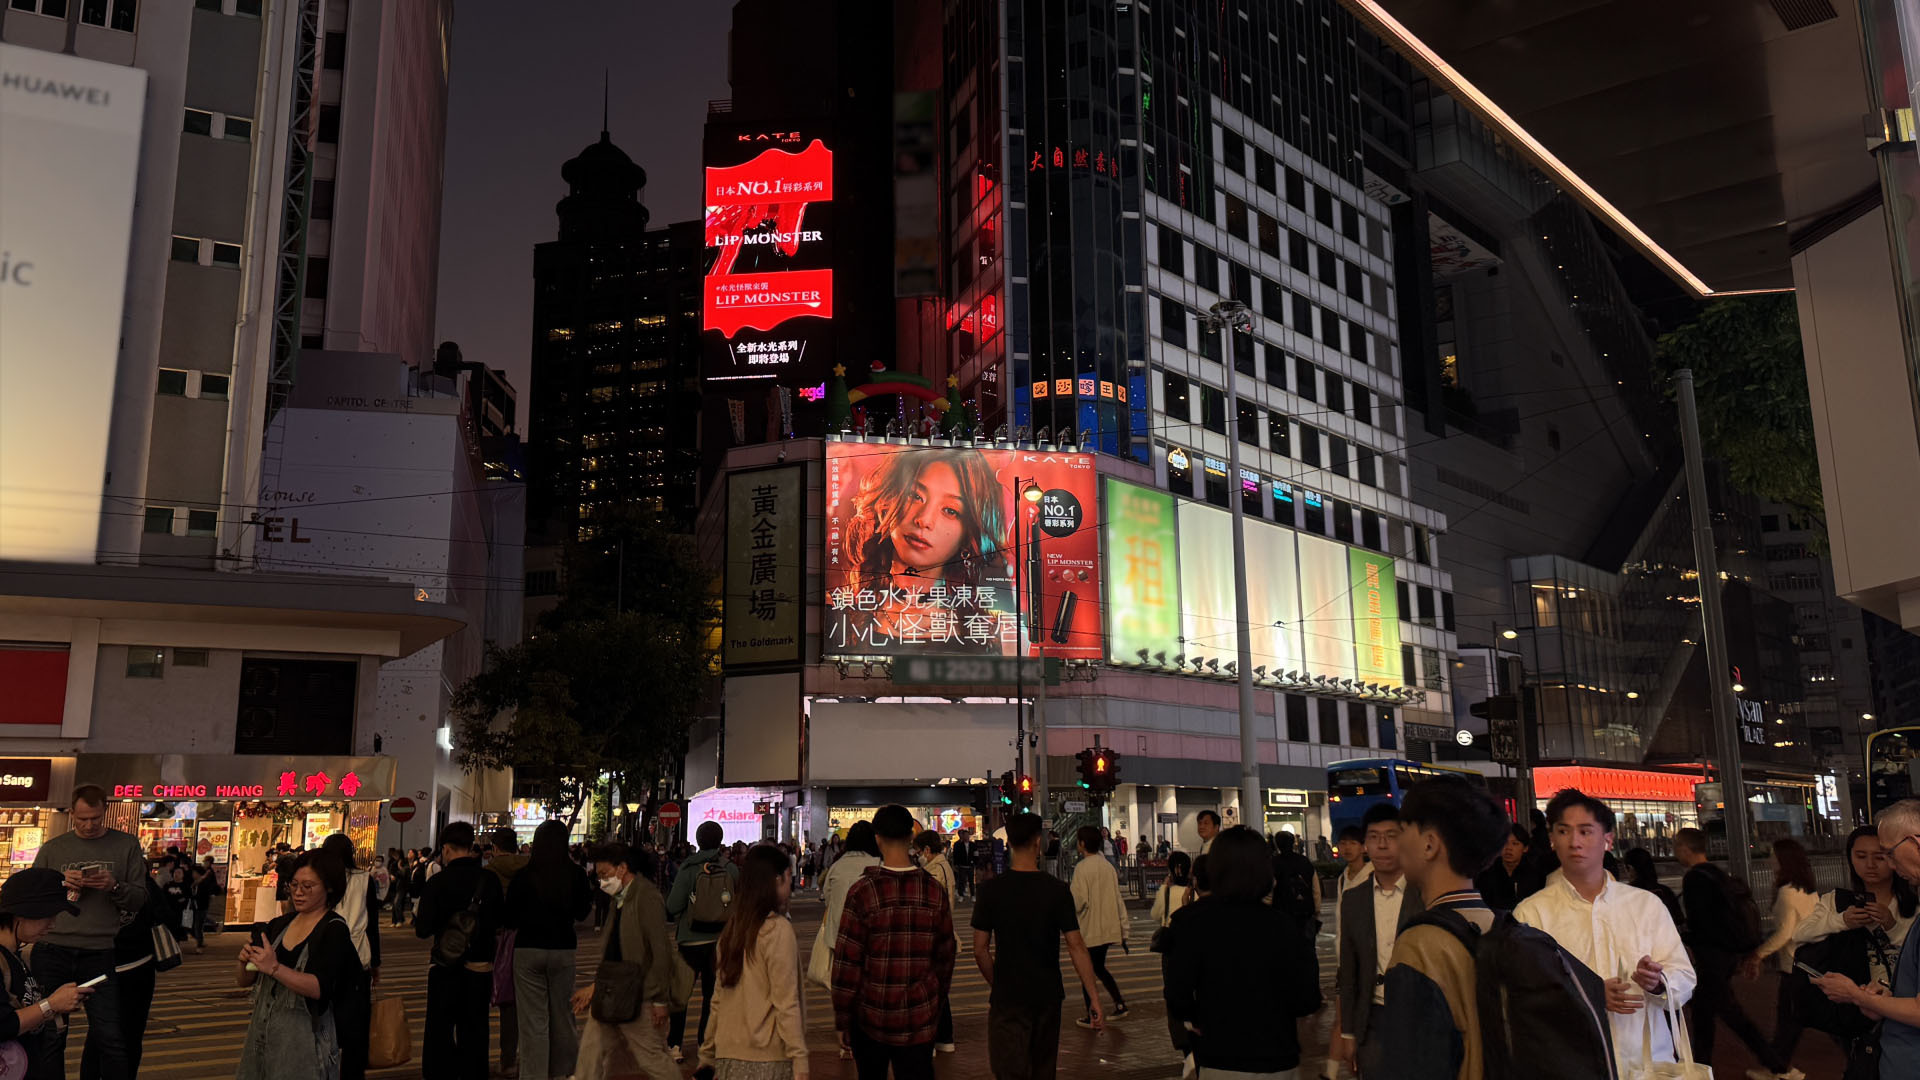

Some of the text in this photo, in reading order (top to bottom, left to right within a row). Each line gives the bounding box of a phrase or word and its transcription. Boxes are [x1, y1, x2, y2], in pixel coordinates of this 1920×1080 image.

[2, 71, 110, 107] HUAWEI
[738, 131, 801, 141] KATE
[714, 230, 824, 247] LIP MONSTER
[715, 290, 821, 305] LIP MONSTER
[736, 340, 798, 354] 全新水光系列
[748, 353, 790, 365] 即將登場
[1023, 455, 1090, 465] KATE
[1043, 495, 1059, 504] 日本
[1044, 505, 1076, 517] NO.1
[748, 484, 778, 622] 黃金廣場
[831, 583, 999, 612] 鎖色水光果凍唇
[829, 610, 1024, 649] 小心怪獸奪唇
[730, 635, 794, 649] The Goldmark
[1735, 697, 1763, 729] ysan
[3, 774, 33, 788] Sang
[113, 784, 264, 798] BEE CHENG HIANG
